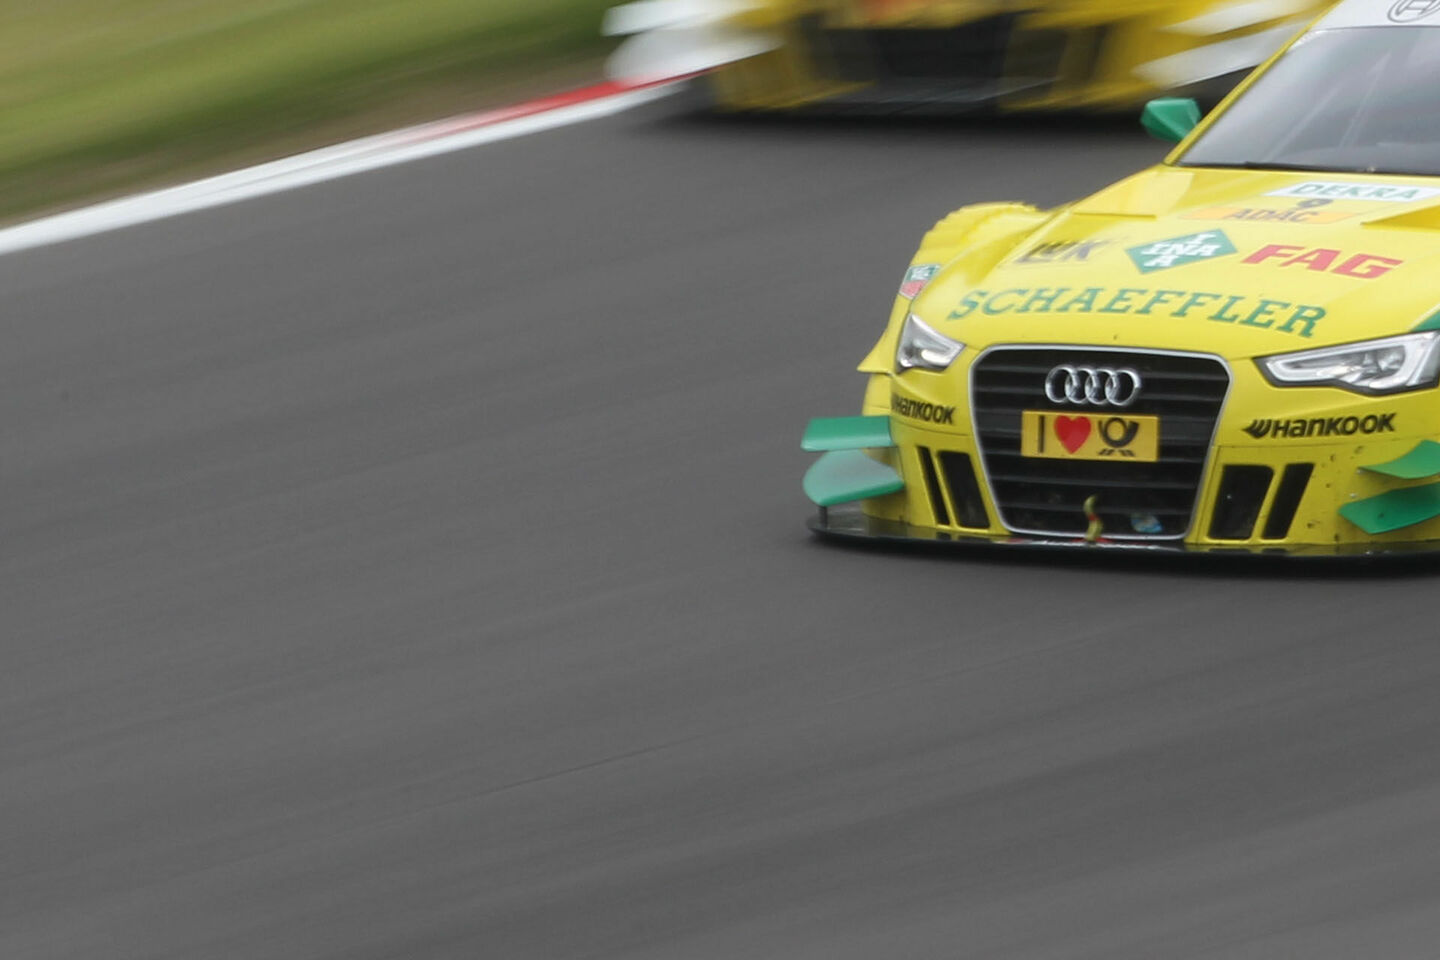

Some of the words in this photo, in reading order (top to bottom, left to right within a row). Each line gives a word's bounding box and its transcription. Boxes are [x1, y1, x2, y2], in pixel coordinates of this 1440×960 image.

[1289, 183, 1420, 199] DEKRA
[1227, 207, 1319, 223] ADAC
[1240, 244, 1403, 279] FAG
[947, 286, 1328, 338] SCHAEFFLER
